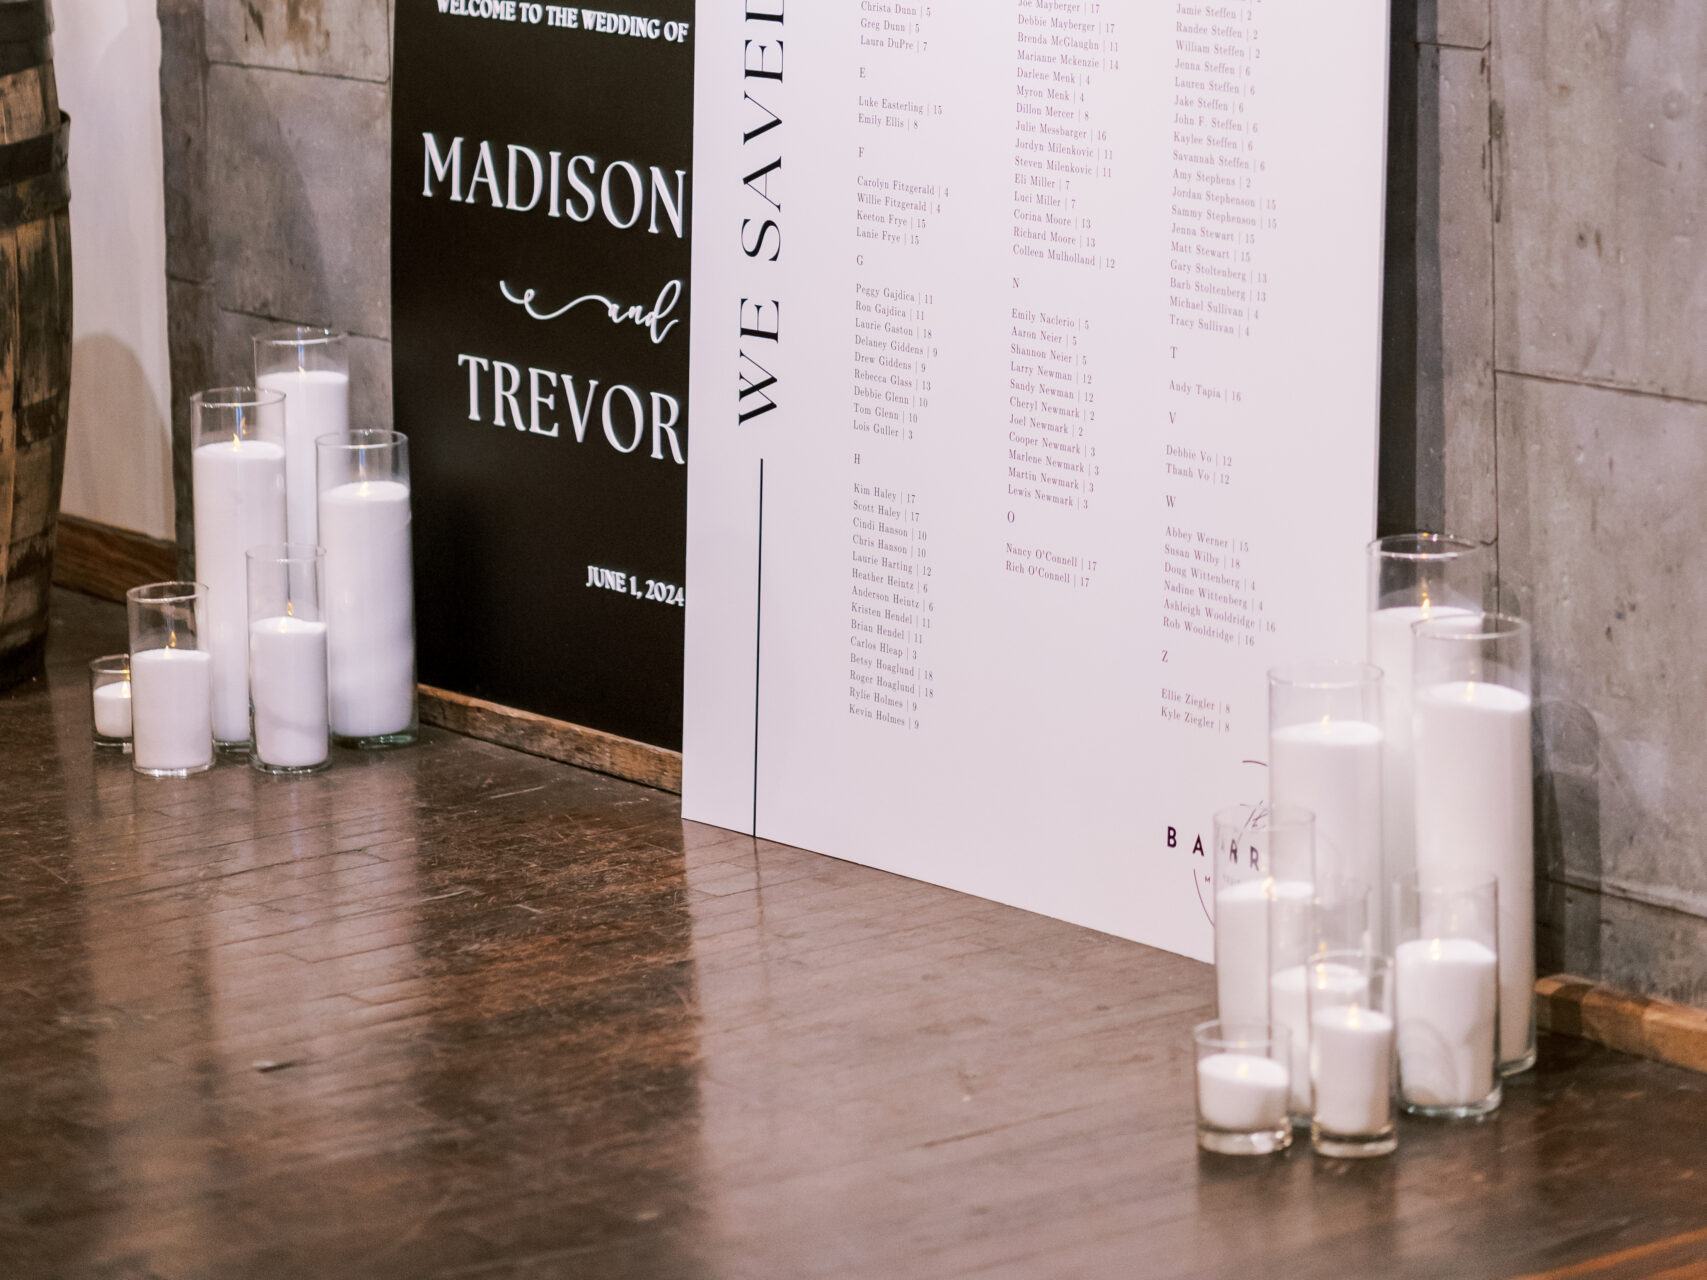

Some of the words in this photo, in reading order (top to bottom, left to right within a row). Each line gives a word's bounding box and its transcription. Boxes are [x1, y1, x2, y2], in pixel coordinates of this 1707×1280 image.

[1090, 3, 1101, 14] 17
[518, 2, 543, 24] TO
[545, 4, 579, 29] THE
[580, 8, 661, 40] WEDDING
[663, 21, 690, 43] OF
[1175, 39, 1210, 54] William
[1213, 43, 1245, 58] Steffen
[859, 66, 866, 79] E
[858, 95, 879, 108] Luke
[881, 98, 924, 116] Easterling
[933, 104, 943, 115] 15
[1173, 94, 1195, 107] Jake
[1197, 96, 1229, 112] Steffen
[1015, 137, 1044, 153] Jordyn
[1047, 141, 1094, 158] Milenkovic
[1104, 149, 1113, 160] 11
[422, 132, 686, 239] MADISON
[1172, 185, 1202, 201] Jordan
[1205, 190, 1256, 208] Stephenson
[1266, 199, 1277, 211] 15
[856, 226, 879, 239] Lanie
[882, 230, 901, 244] Frye
[910, 234, 920, 246] 15
[1013, 225, 1047, 241] Richard
[1049, 231, 1076, 246] Moore
[1086, 236, 1096, 248] 13
[1171, 222, 1197, 237] Jenna
[1199, 226, 1234, 242] Stewart
[1245, 233, 1255, 245] 15
[1170, 258, 1192, 275] Gary
[1195, 262, 1247, 283] Stoltenberg
[1257, 272, 1267, 284] 13
[855, 317, 882, 331] Laurie
[884, 321, 913, 337] Gaston
[923, 328, 932, 340] 18
[738, 297, 780, 427] WE
[1010, 360, 1034, 377] Larry
[1037, 365, 1072, 381] Newman
[1083, 373, 1092, 385] 12
[854, 367, 887, 384] Rebecca
[890, 374, 912, 388] Glass
[922, 380, 931, 391] 13
[1169, 379, 1192, 396] Andy
[1195, 383, 1221, 400] Tapia
[1232, 390, 1242, 402] 16
[457, 353, 685, 465] TREVOR
[1009, 395, 1038, 413] Cheryl
[1041, 401, 1080, 419] Newmark
[1169, 411, 1177, 425] V
[854, 453, 861, 465] H
[1166, 444, 1197, 461] Debbie
[1200, 450, 1212, 463] Vo
[1223, 455, 1232, 467] 12
[1008, 483, 1032, 498] Lewis
[1034, 488, 1073, 507] Newmark
[1165, 494, 1176, 508] W
[852, 499, 874, 513] Scott
[878, 504, 901, 521] Haley
[911, 511, 920, 523] 17
[1164, 543, 1190, 559] Susan
[1193, 548, 1220, 567] Wilby
[1231, 557, 1241, 569] 18
[585, 565, 627, 593] JUNE
[629, 575, 643, 600] 1,
[644, 579, 685, 607] 2024
[850, 669, 873, 685] Roger
[876, 675, 915, 694] Hoaglund
[925, 687, 934, 699] 18
